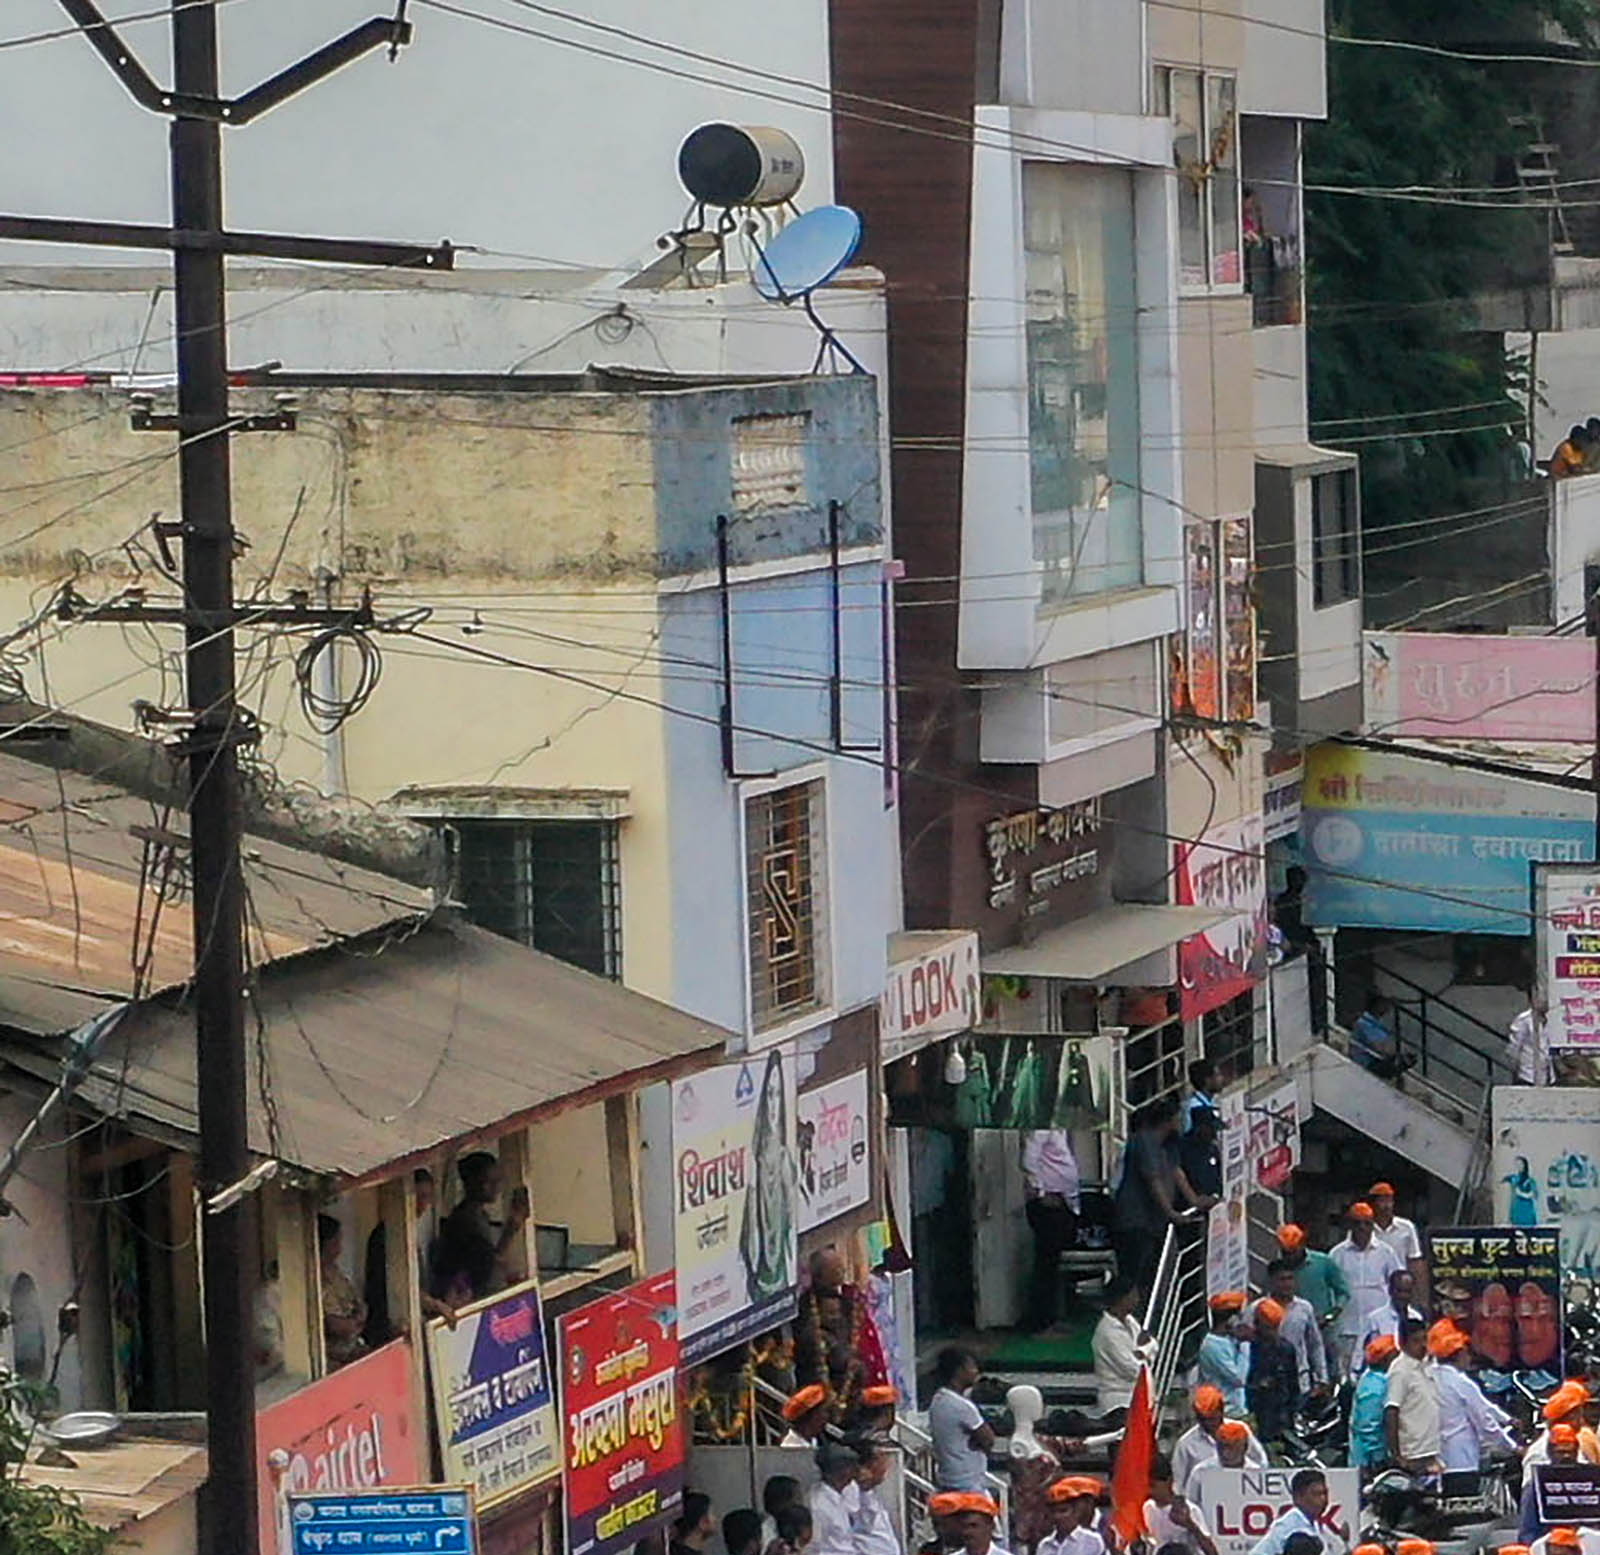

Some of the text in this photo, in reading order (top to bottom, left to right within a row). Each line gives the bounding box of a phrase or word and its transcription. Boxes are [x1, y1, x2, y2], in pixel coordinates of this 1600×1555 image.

[901, 952, 960, 1031] LOOK
[677, 1139, 748, 1215] शिवांश
[1431, 1237, 1475, 1263] सुरज
[1480, 1237, 1510, 1264] फुट
[312, 1412, 385, 1489] airtel
